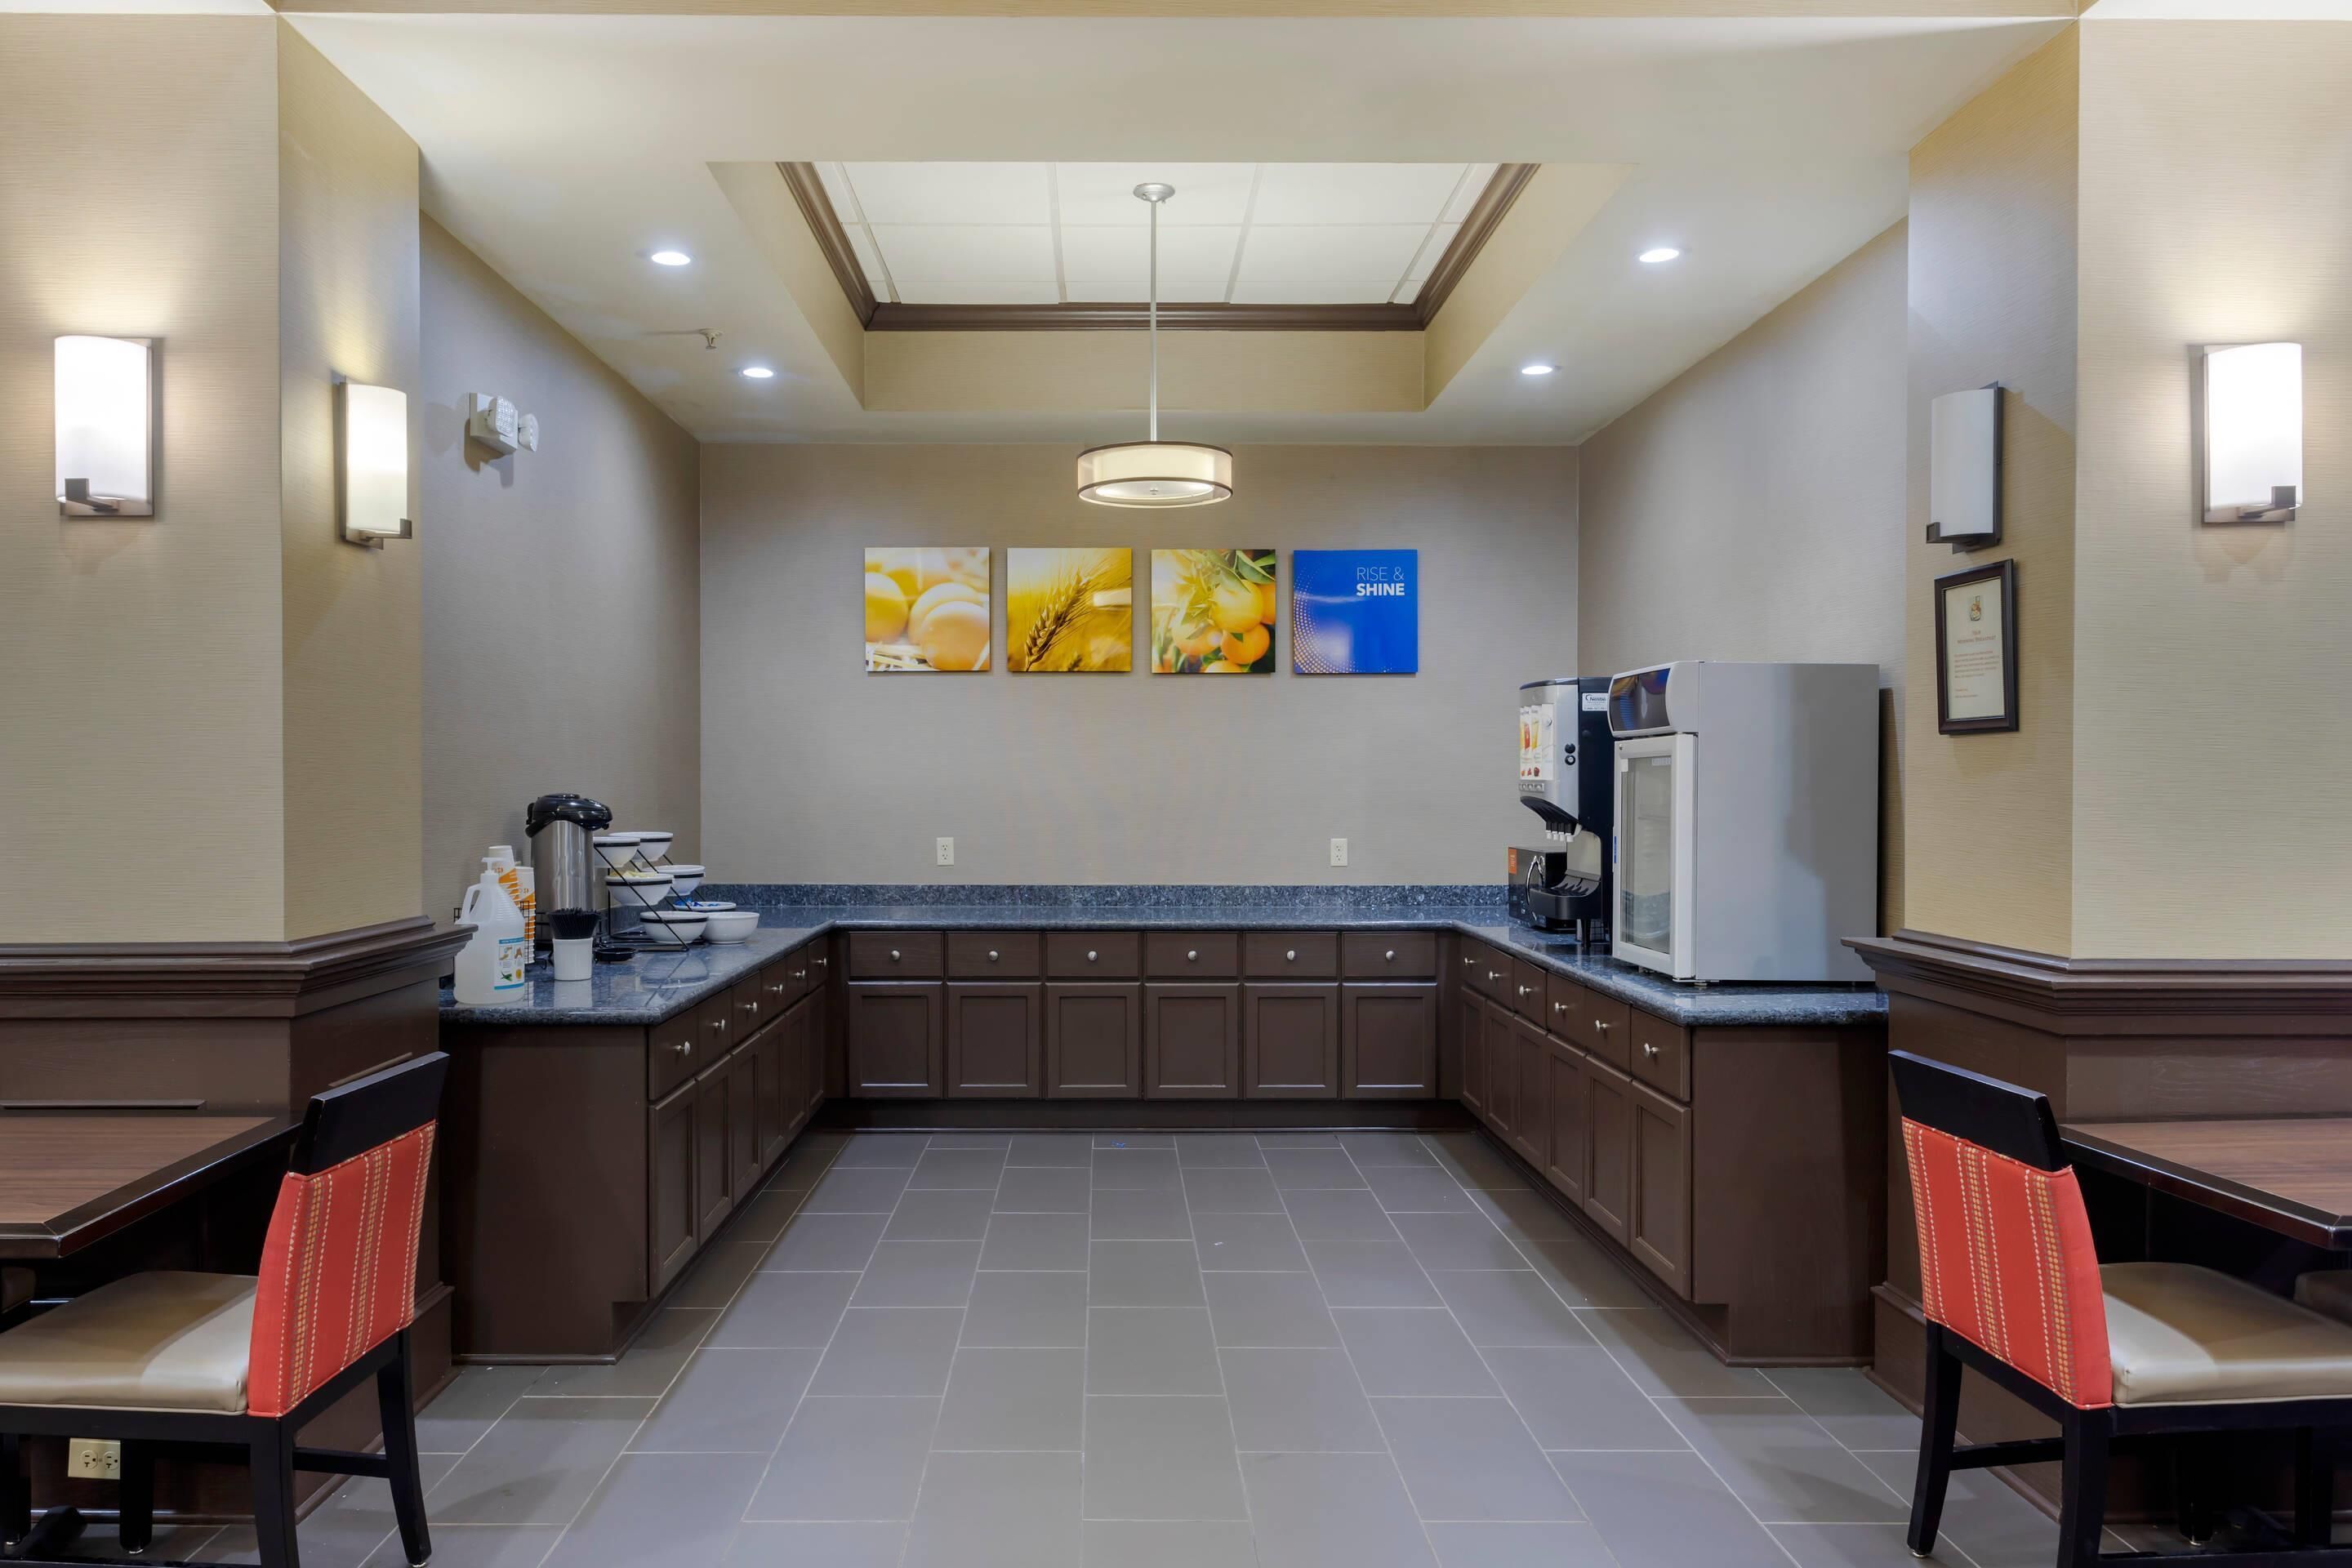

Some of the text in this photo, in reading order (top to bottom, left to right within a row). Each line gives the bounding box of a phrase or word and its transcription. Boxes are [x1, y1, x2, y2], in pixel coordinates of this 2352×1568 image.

[1356, 567, 1405, 581] RISE &
[1356, 582, 1405, 596] SHINE
